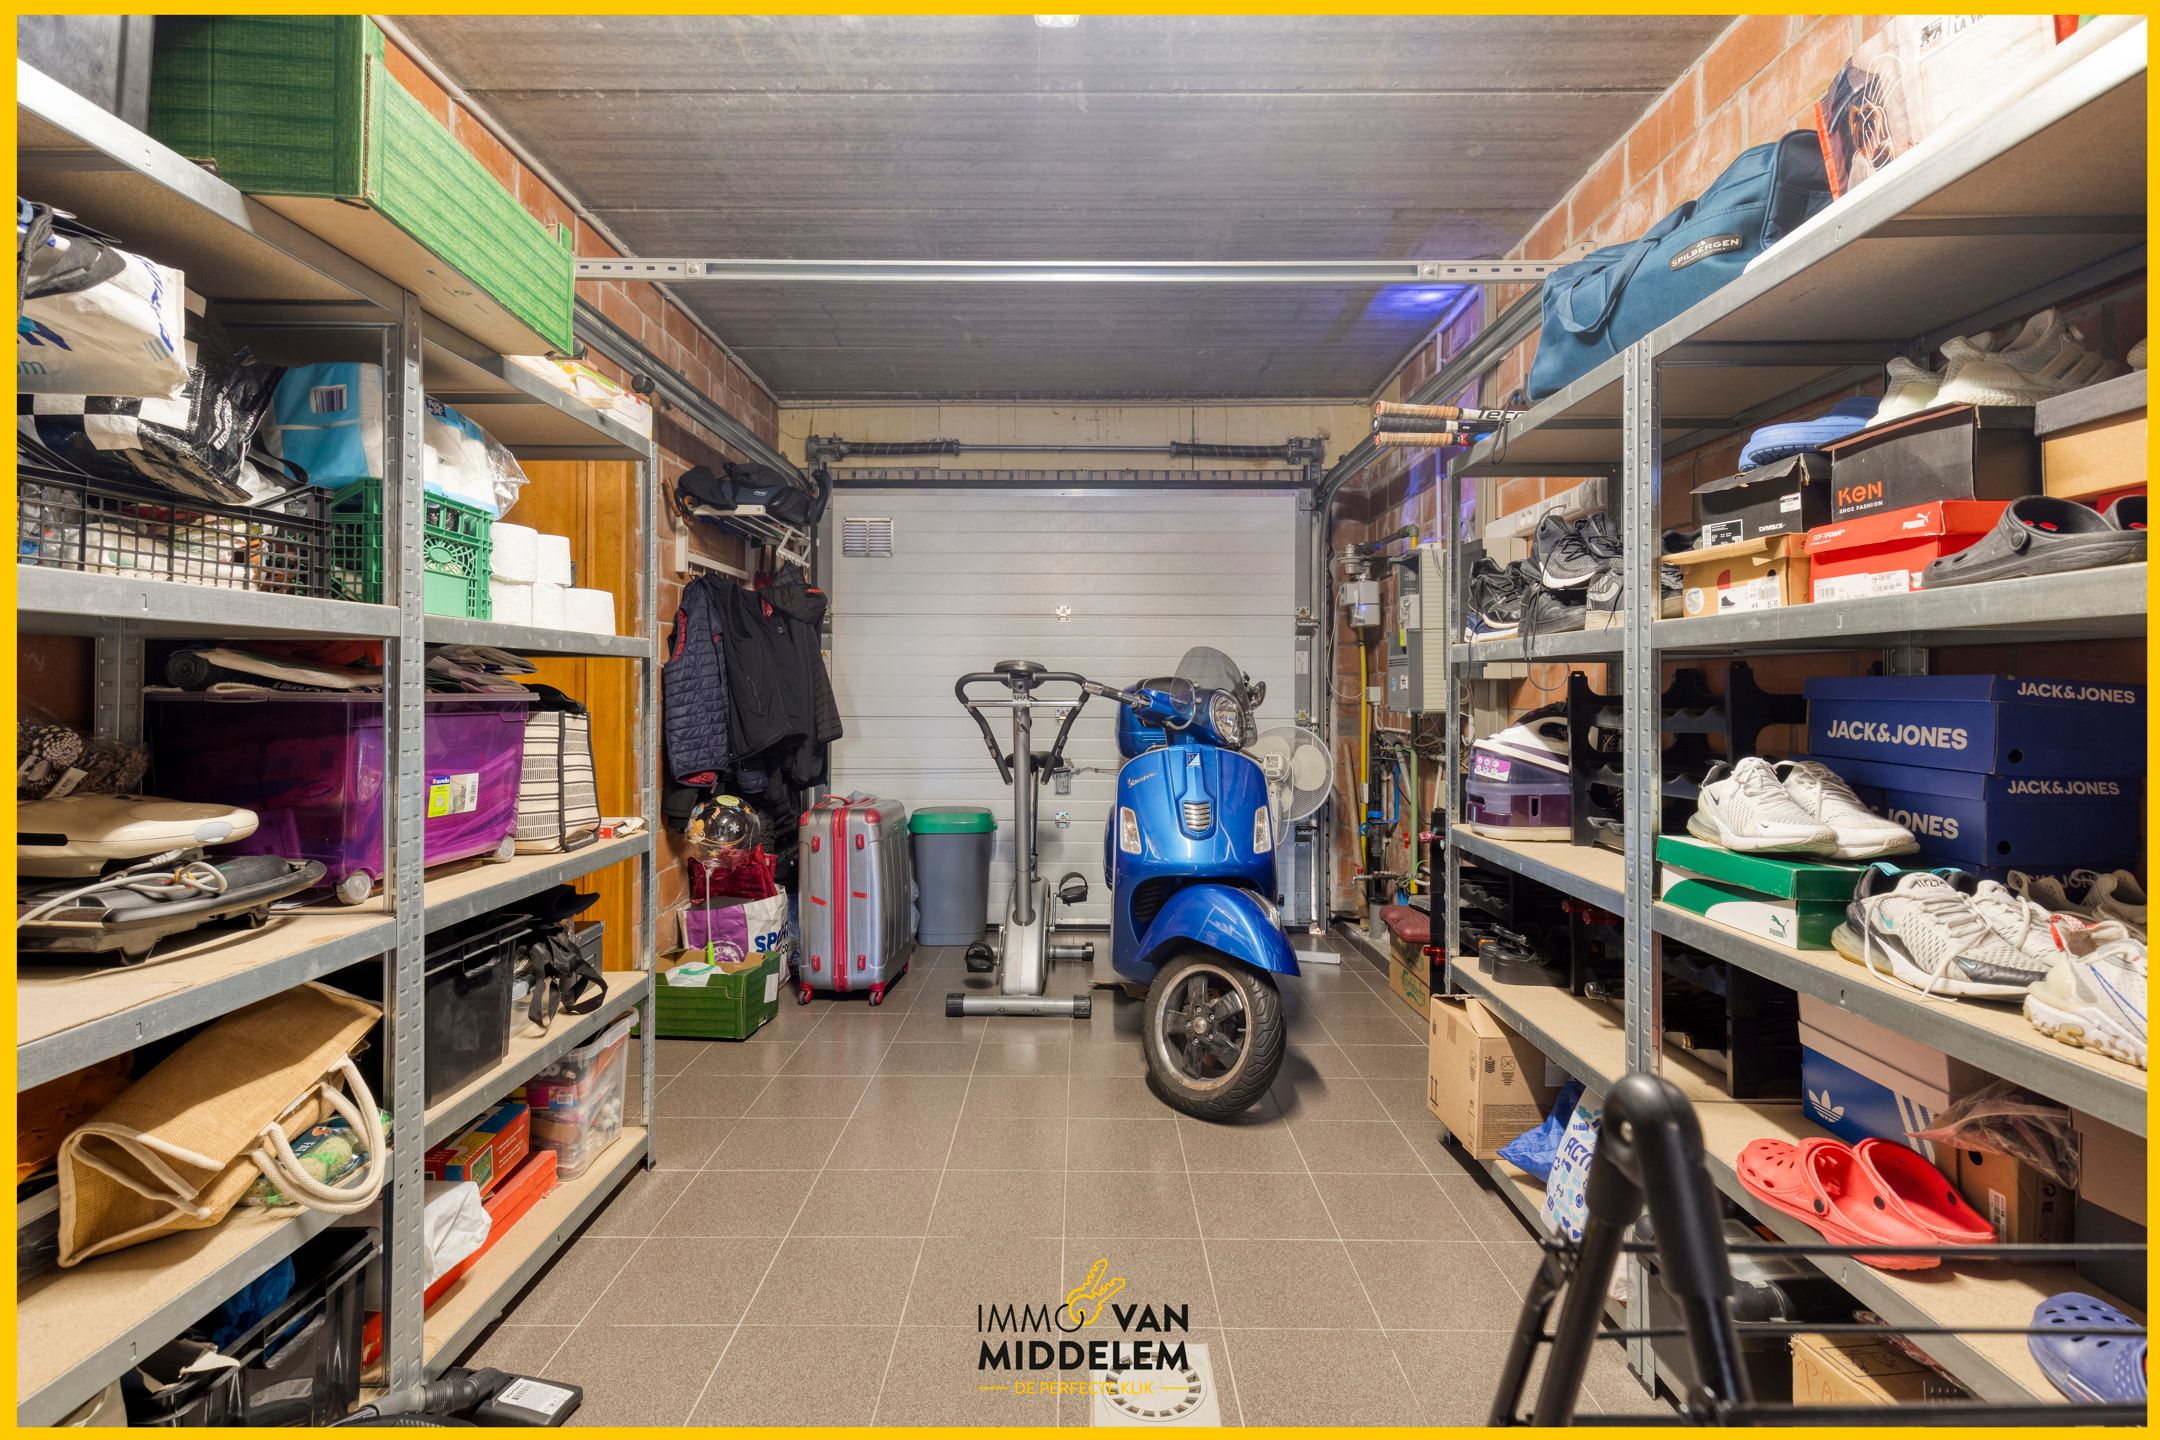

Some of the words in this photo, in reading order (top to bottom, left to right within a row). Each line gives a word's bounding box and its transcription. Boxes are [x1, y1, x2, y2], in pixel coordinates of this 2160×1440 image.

[1671, 238, 1739, 267] SPILBERGEN
[1856, 500, 1883, 511] FASHION
[2017, 682, 2136, 704] JACK&JONES
[1827, 719, 1968, 750] JACK&JONES
[2008, 780, 2120, 796] JACK&JONES
[1769, 928, 1785, 938] PUMA
